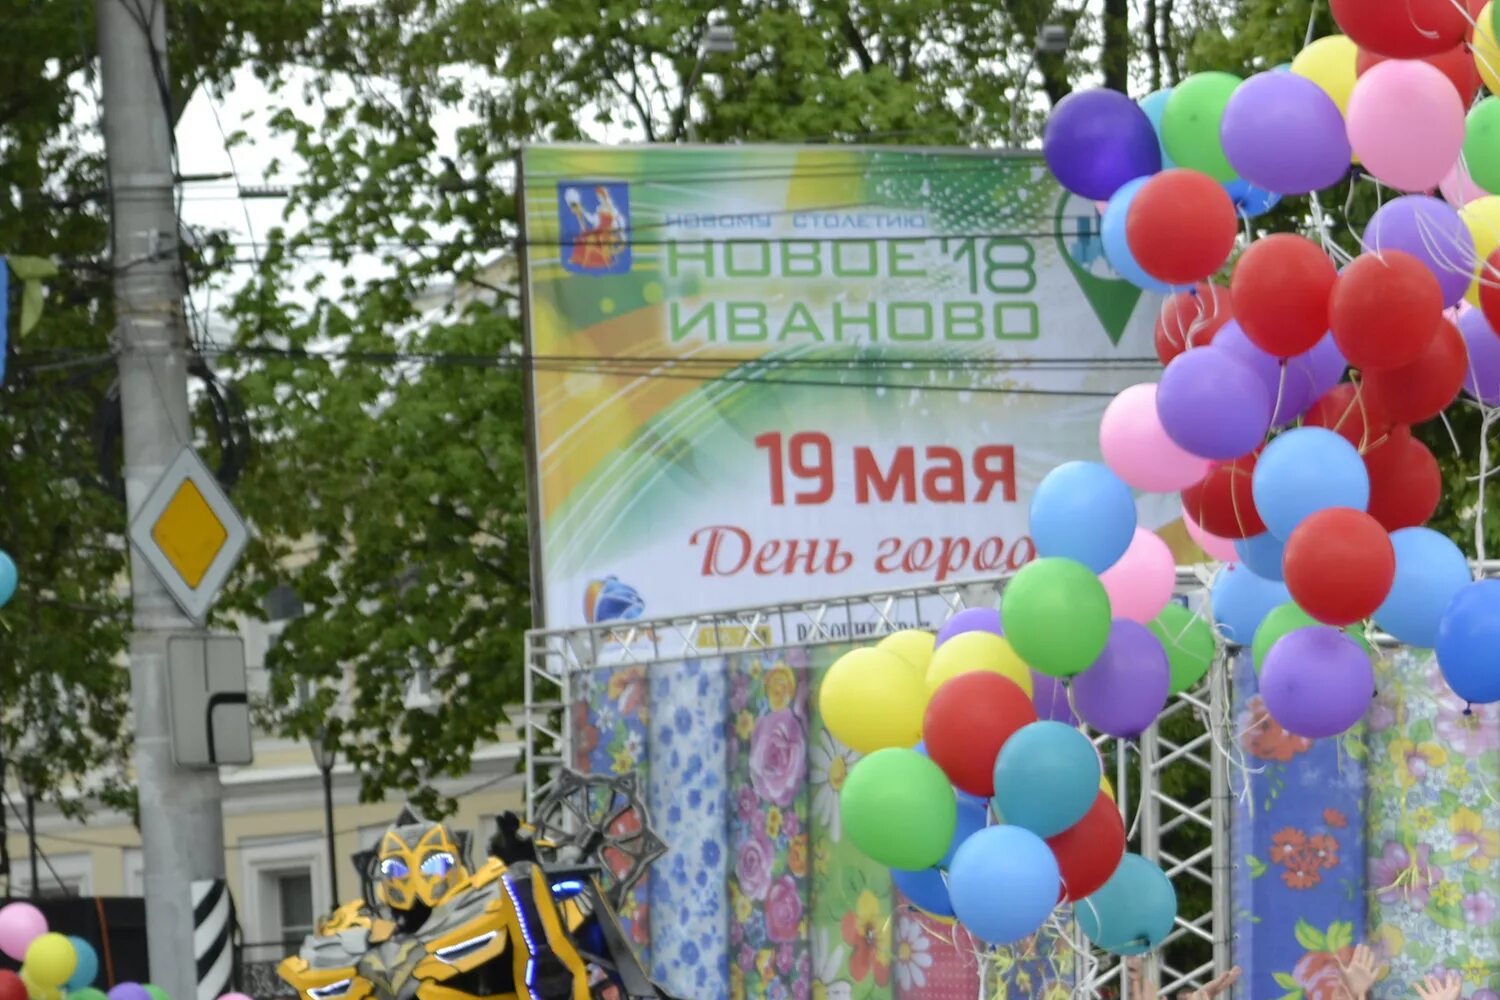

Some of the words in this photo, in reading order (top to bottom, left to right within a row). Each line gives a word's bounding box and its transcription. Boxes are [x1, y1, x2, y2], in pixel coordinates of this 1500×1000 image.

[665, 213, 772, 229] НОВОМУ
[792, 212, 927, 229] СТОЛЕТИЮ
[666, 238, 928, 278] НОВОЕ
[669, 301, 1040, 343] ИВАНОВО
[754, 431, 834, 506] 19
[853, 444, 1018, 505] мая
[689, 525, 854, 577] День
